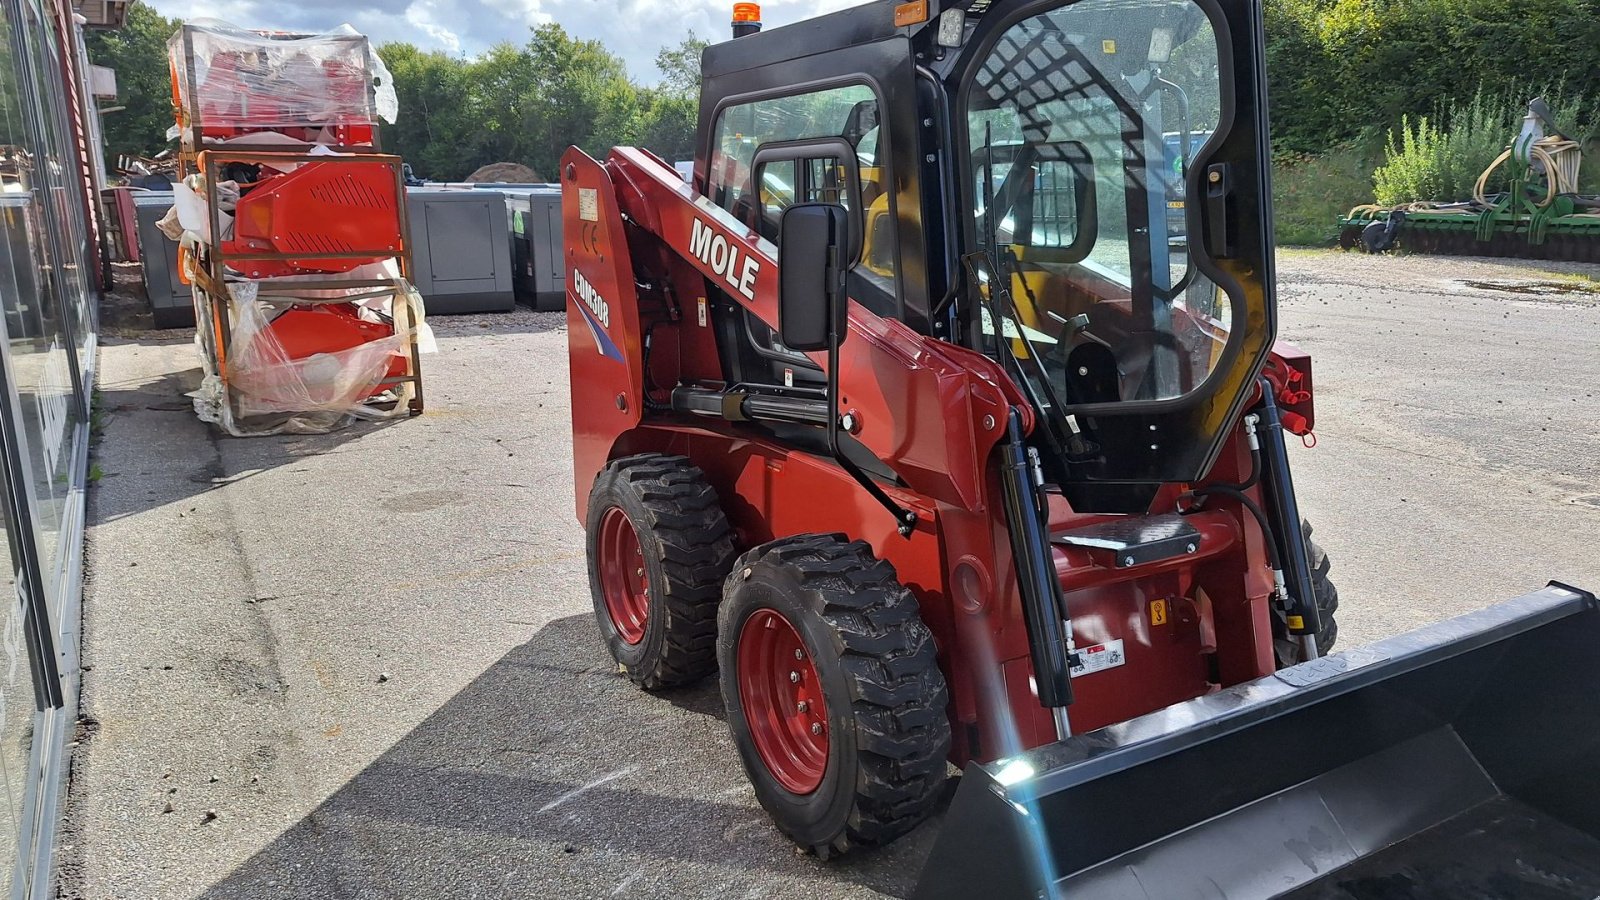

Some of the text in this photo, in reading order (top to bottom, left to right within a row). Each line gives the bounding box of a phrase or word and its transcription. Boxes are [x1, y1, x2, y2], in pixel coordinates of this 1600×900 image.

[582, 222, 598, 255] CE
[689, 216, 760, 301] MOLE
[574, 267, 609, 329] CDM308
